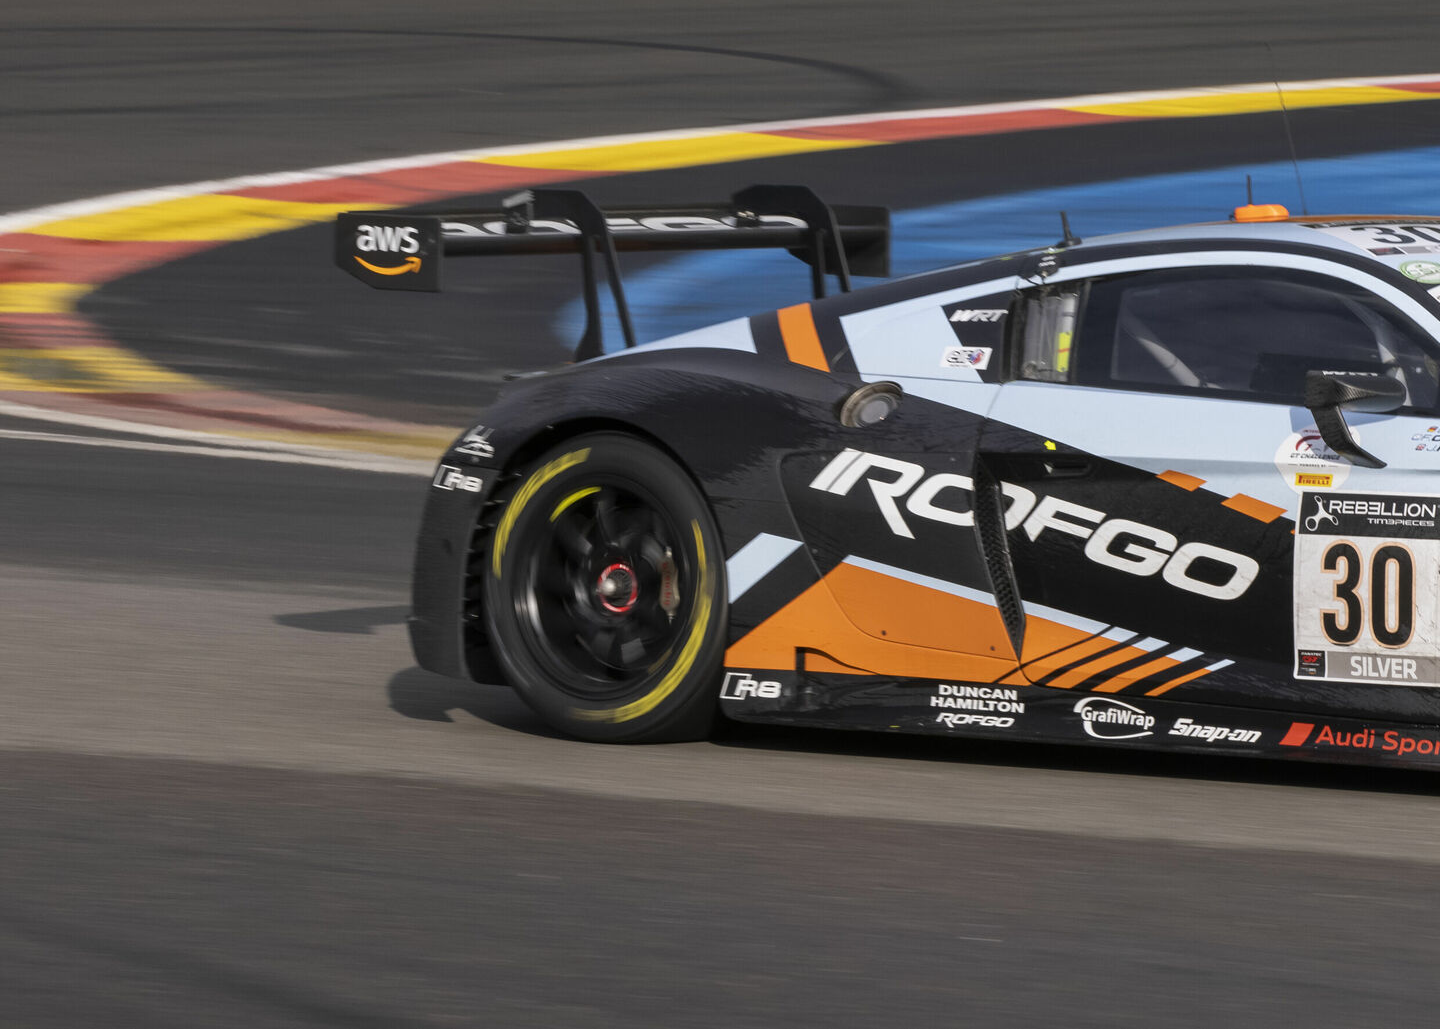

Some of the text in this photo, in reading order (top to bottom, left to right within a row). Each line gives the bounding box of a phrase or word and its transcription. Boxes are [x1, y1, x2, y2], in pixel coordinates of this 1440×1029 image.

[356, 224, 420, 253] aws
[443, 472, 483, 492] R8
[1298, 475, 1331, 485] PIRELLI
[1320, 539, 1417, 649] 30
[1350, 655, 1418, 680] SILVER
[734, 679, 782, 699] R8
[938, 684, 1018, 700] DUNCAN
[930, 696, 1025, 713] HAMILTON
[1080, 706, 1155, 730] GrafiWrap
[1168, 717, 1262, 742] Snap-on
[1315, 725, 1376, 749] Audi
